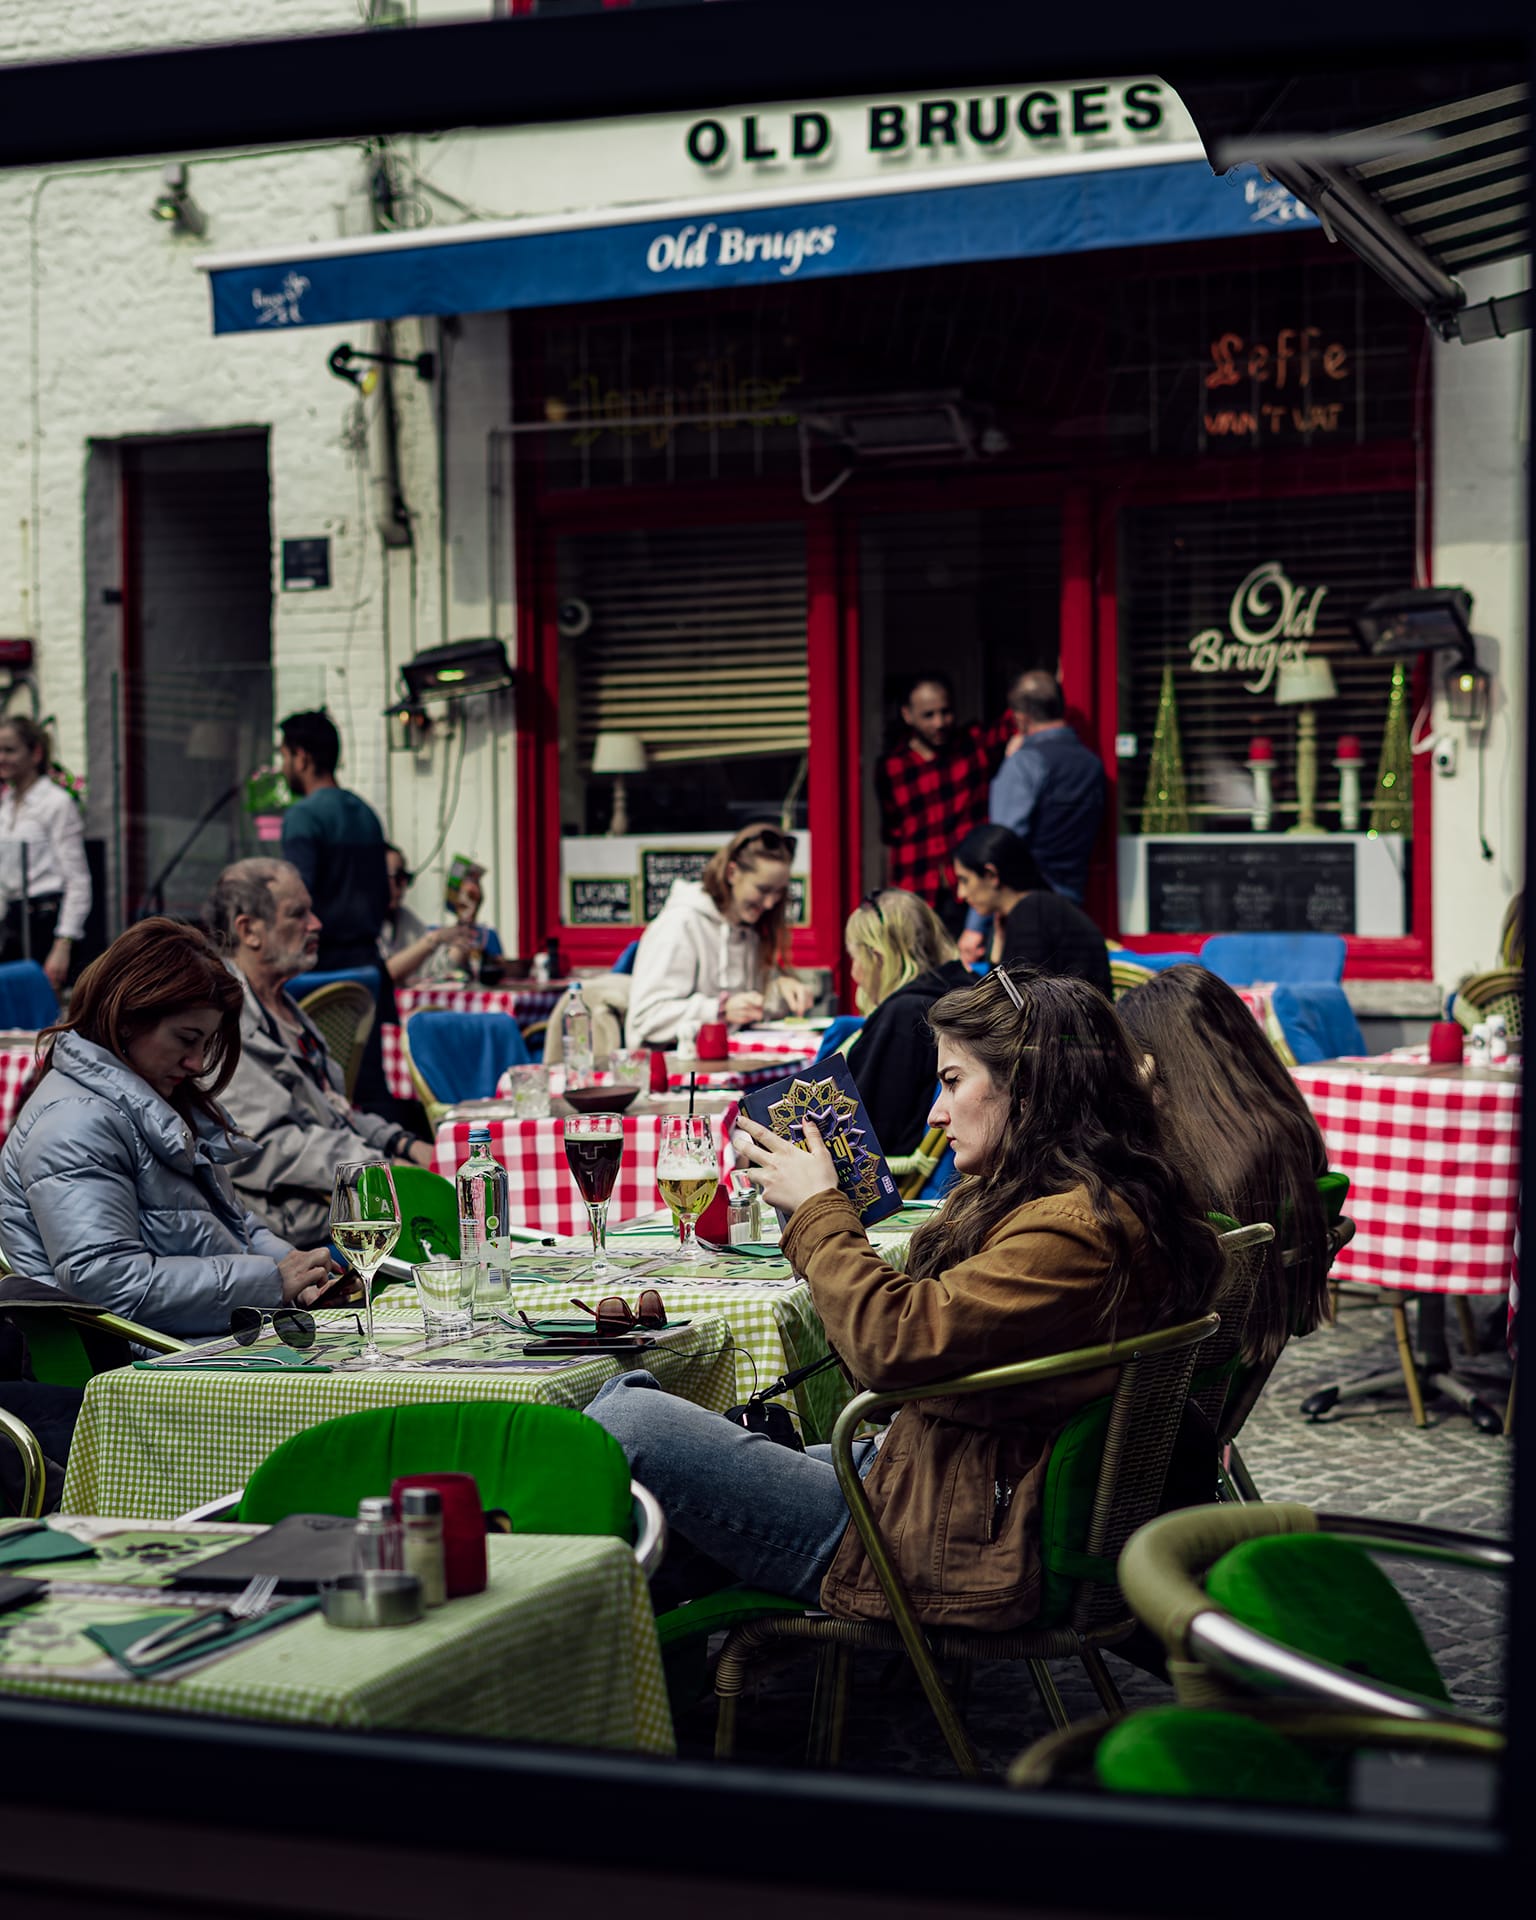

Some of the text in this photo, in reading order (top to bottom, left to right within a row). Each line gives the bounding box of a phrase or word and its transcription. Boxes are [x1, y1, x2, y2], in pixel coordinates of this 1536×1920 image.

[686, 83, 1165, 165] OLD BRUGES
[647, 222, 837, 276] Old Bruges
[1204, 326, 1352, 390] Leffe
[1230, 561, 1328, 645] Old
[1189, 628, 1310, 694] Bruges
